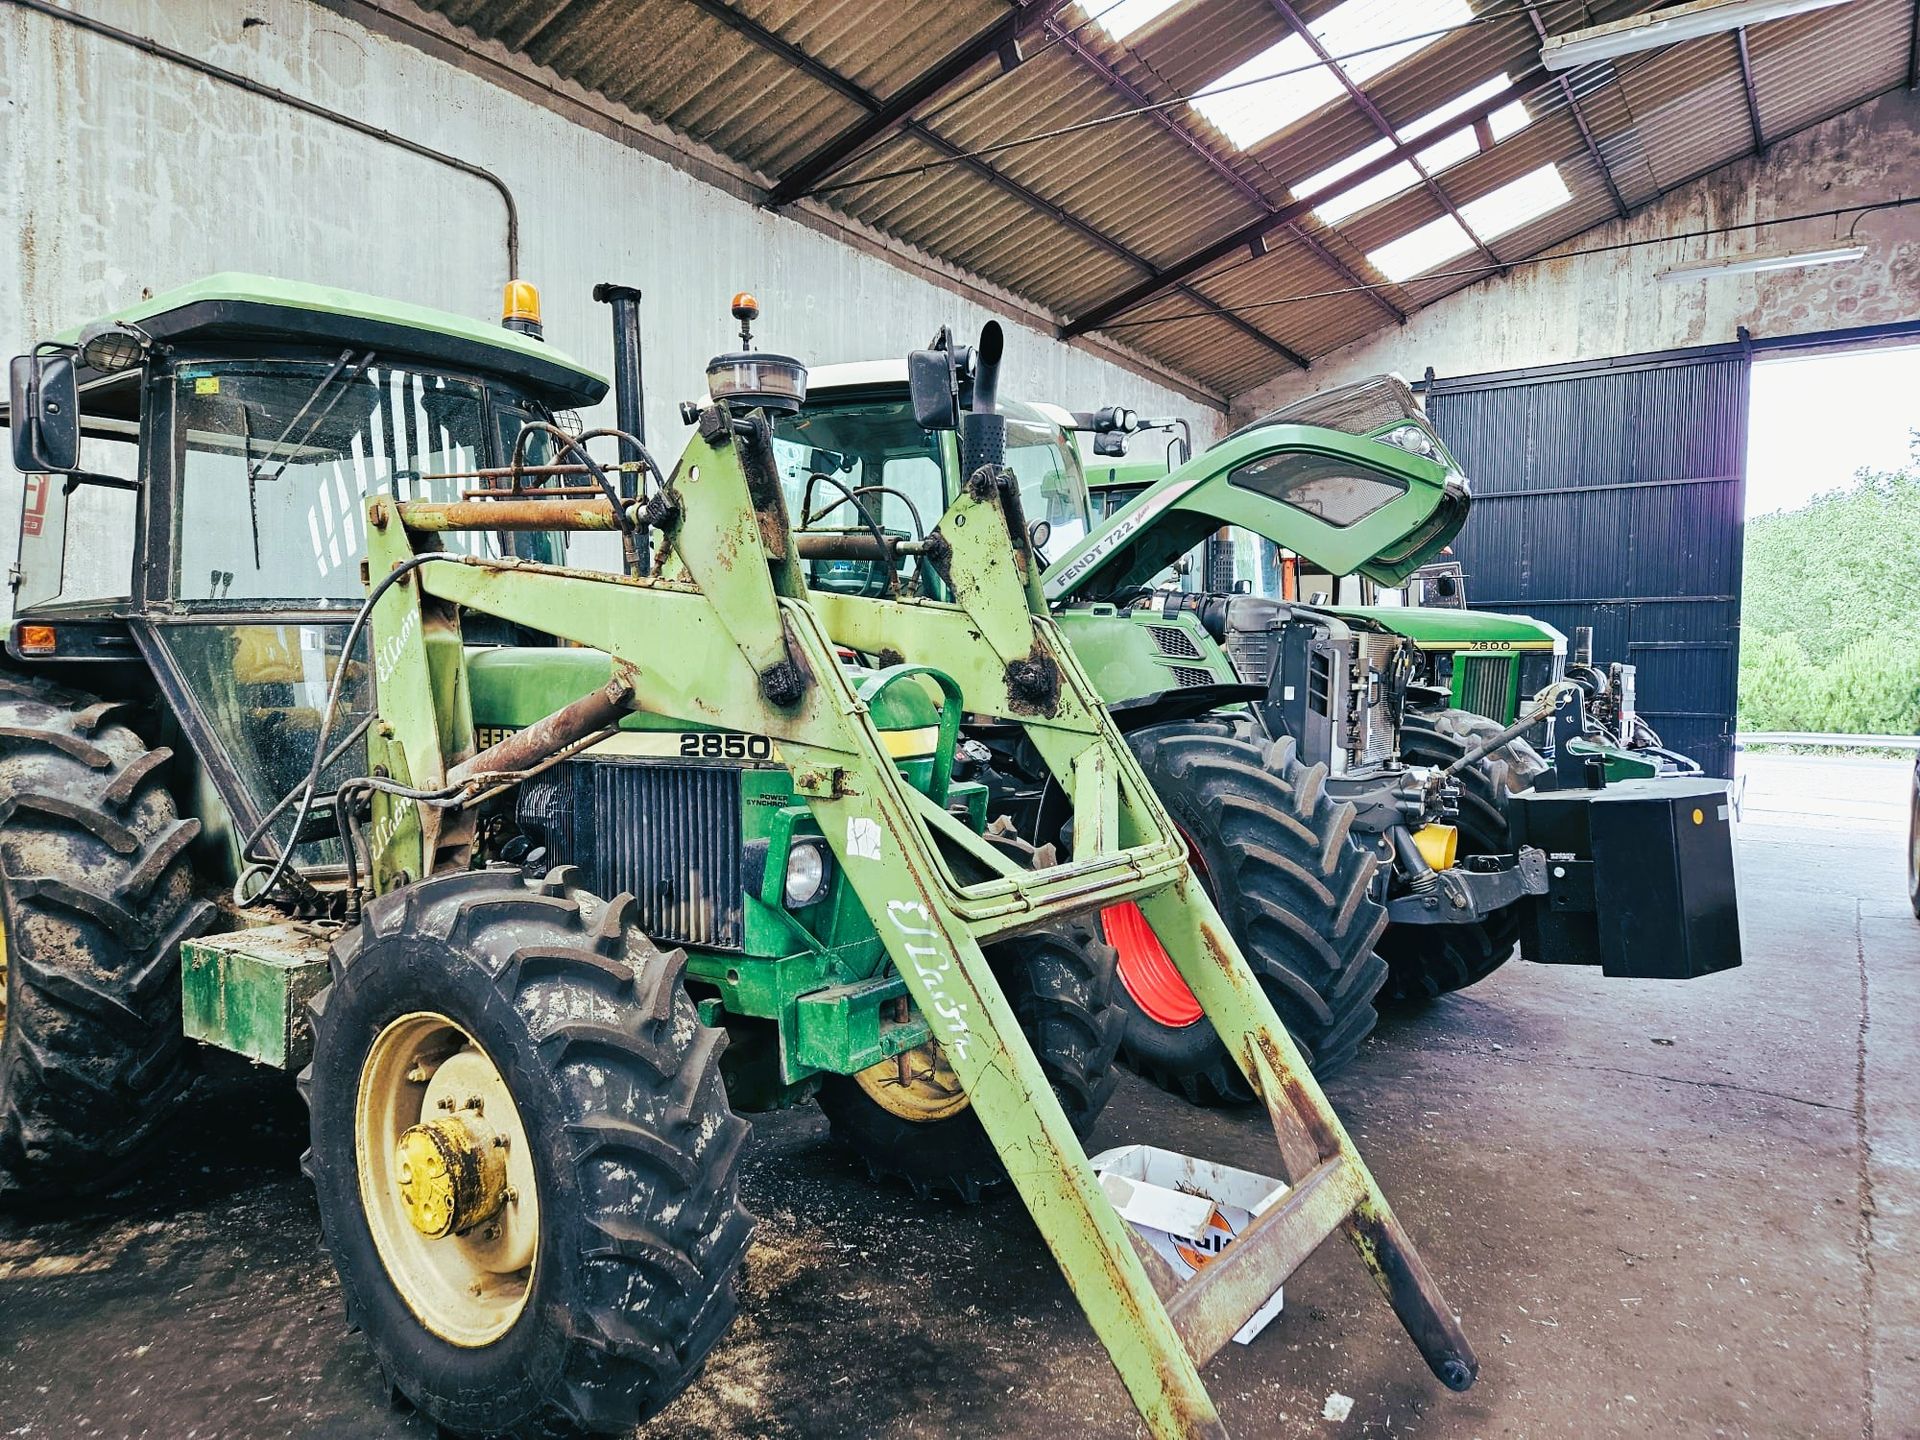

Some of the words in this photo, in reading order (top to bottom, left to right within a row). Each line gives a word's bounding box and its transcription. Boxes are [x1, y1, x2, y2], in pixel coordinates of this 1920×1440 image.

[1056, 544, 1103, 587] FENDT
[1104, 521, 1134, 546] 722
[1470, 641, 1510, 650] 7800
[680, 733, 771, 760] 2850
[759, 793, 789, 801] POWER
